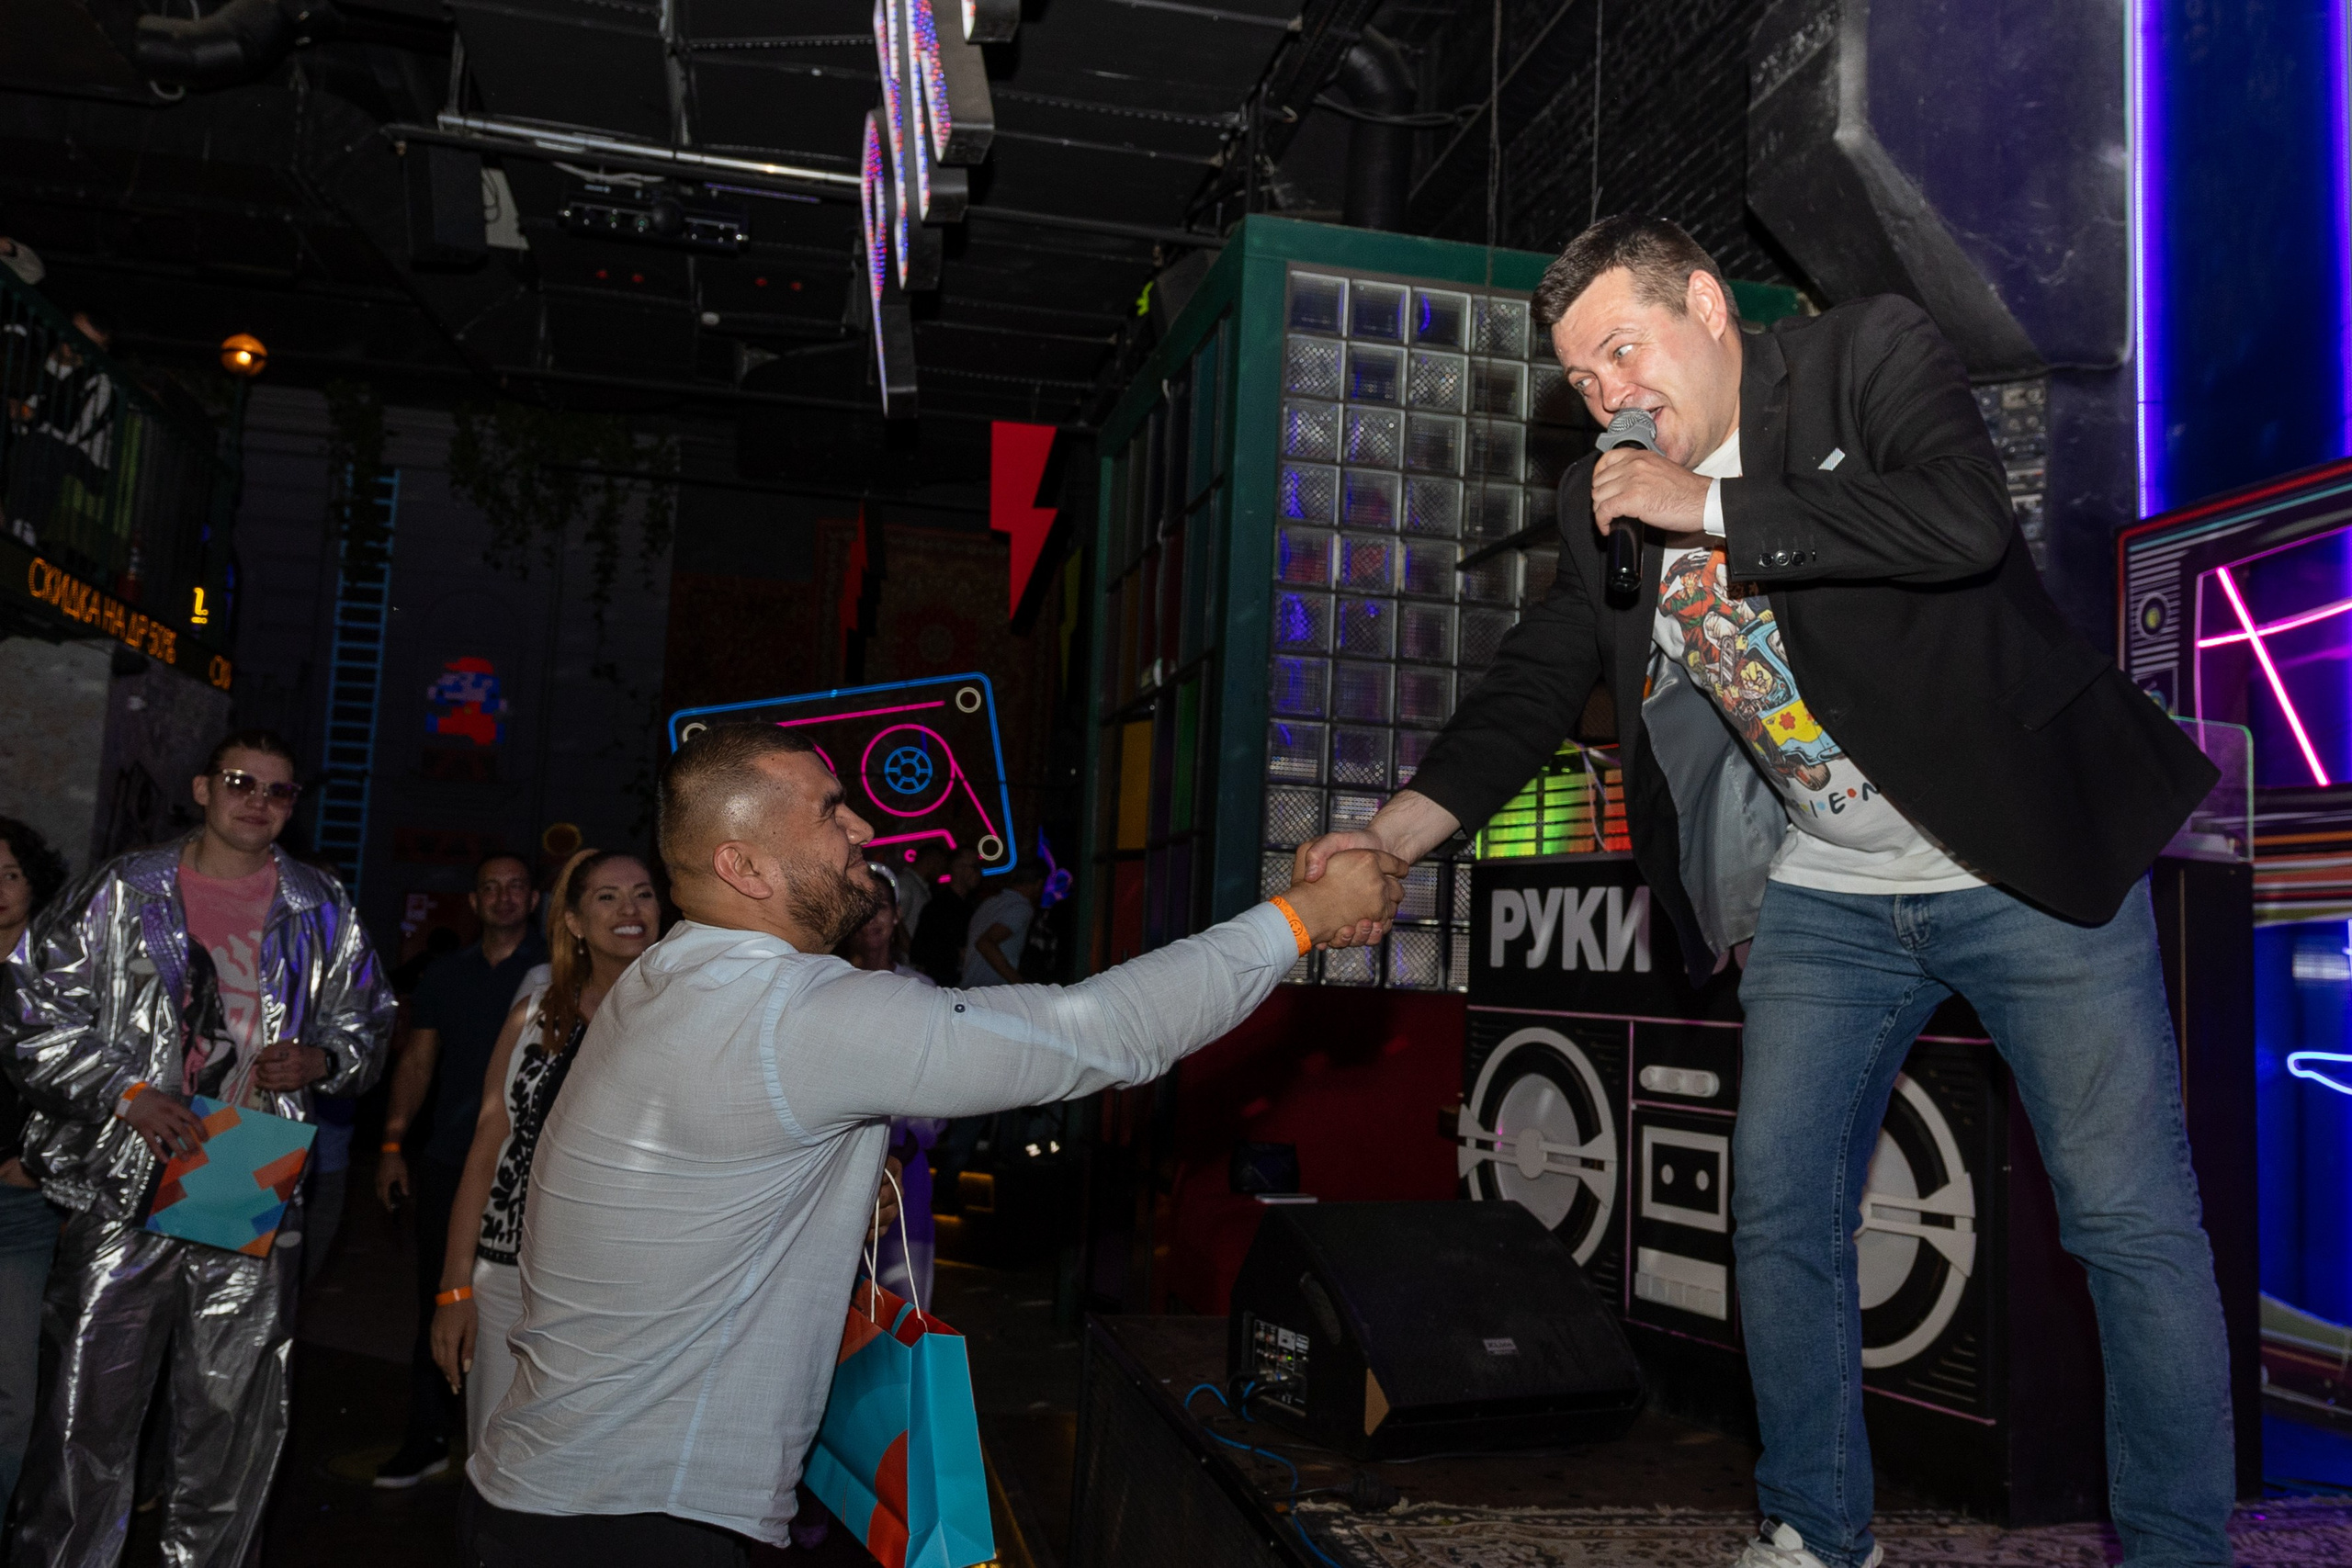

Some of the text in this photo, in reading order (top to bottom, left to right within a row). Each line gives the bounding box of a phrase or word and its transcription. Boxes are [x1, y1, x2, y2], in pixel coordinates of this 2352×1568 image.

[28, 557, 101, 626] СКИДКА
[102, 595, 126, 640] НА
[1489, 885, 1652, 973] РУКИ
